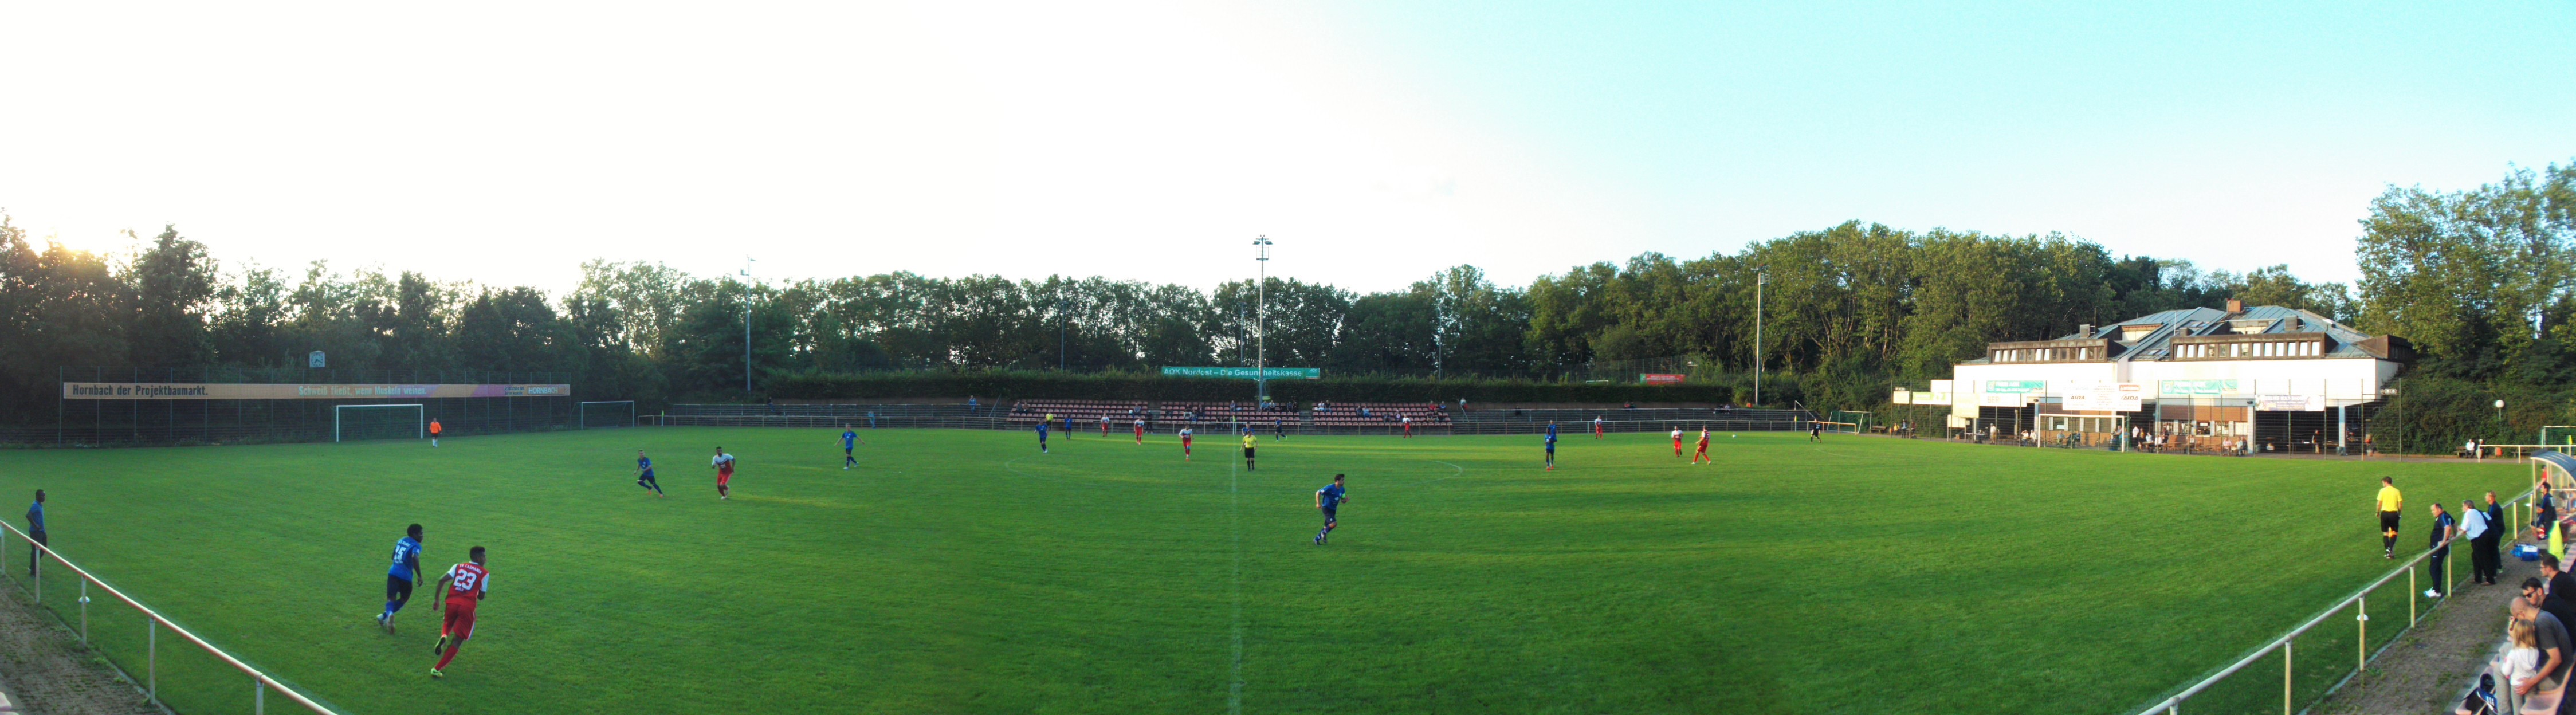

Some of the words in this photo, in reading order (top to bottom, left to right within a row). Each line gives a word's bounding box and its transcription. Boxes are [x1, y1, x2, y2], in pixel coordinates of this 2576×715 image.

[73, 384, 113, 395] Hornbach
[117, 385, 131, 395] der
[135, 385, 209, 398] Projektbaumarkt.
[299, 386, 328, 396] Schweiß
[355, 387, 372, 395] wenn
[375, 386, 401, 395] Muskeln
[403, 387, 427, 395] weinen.
[453, 569, 477, 590] 23
